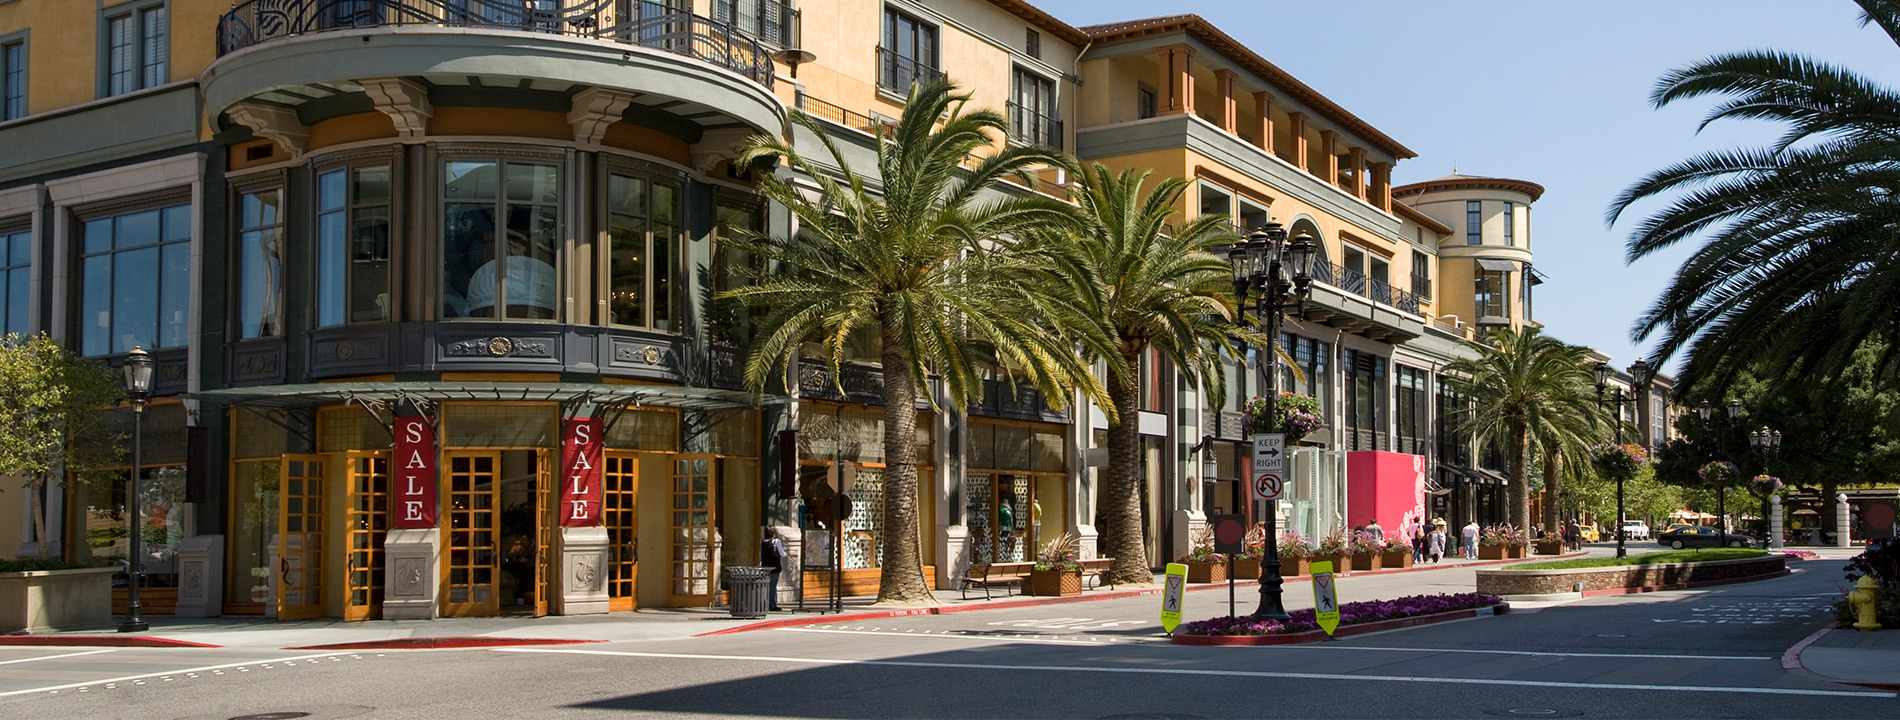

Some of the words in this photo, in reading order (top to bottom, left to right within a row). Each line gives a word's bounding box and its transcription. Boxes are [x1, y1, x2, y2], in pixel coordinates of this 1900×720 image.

[1256, 458, 1282, 467] RIGHT
[1258, 438, 1280, 447] KEEP
[404, 421, 426, 521] SALE
[570, 424, 592, 519] SALE
